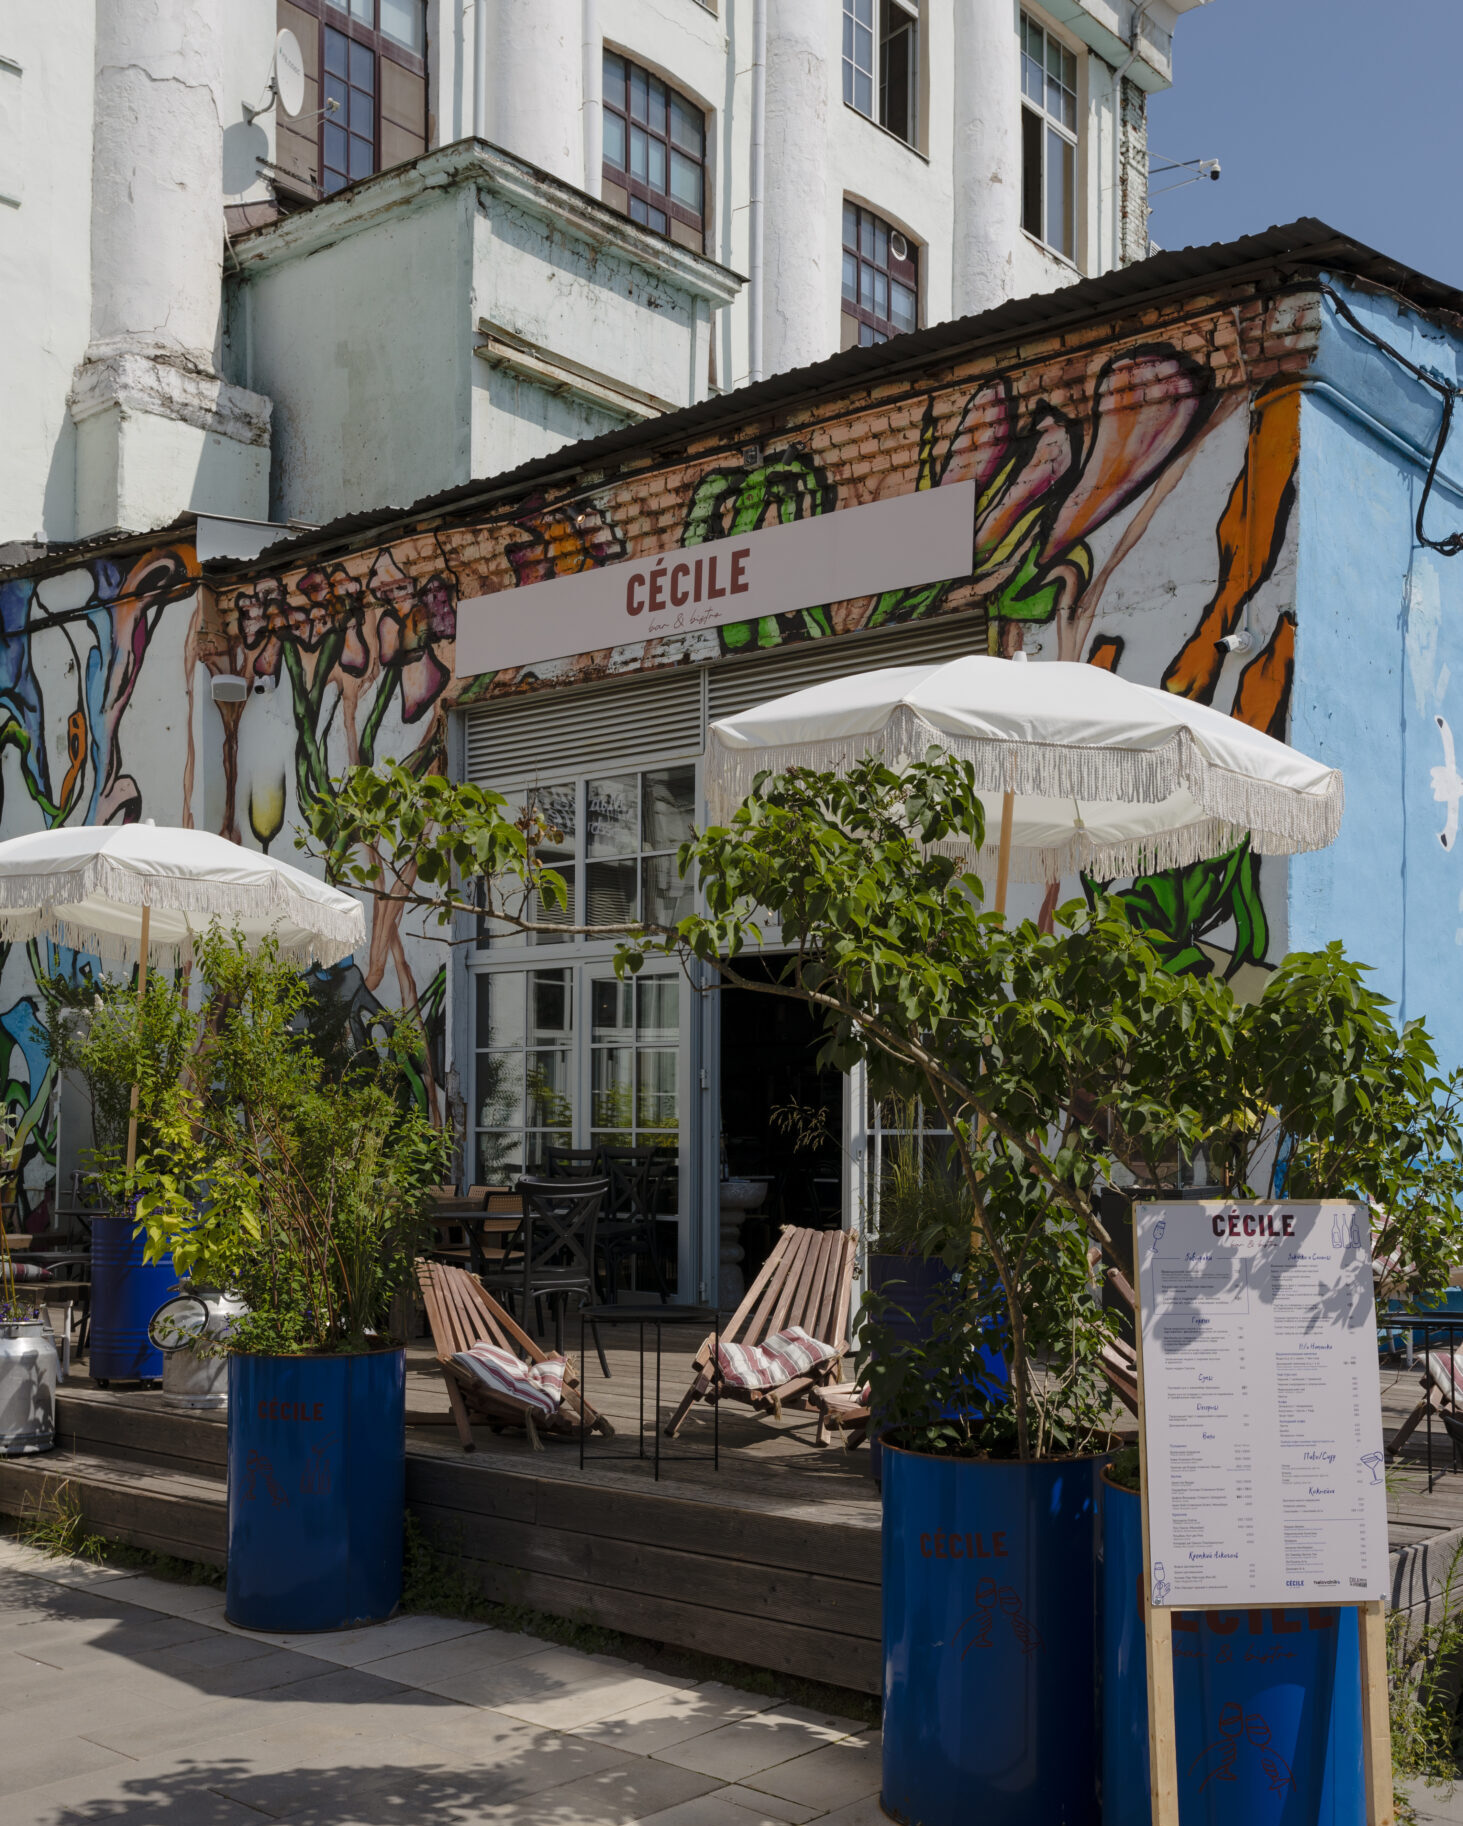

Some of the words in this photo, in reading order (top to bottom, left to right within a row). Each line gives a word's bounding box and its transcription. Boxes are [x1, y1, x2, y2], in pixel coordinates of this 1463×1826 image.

[626, 548, 751, 616] CÉCILE
[648, 618, 670, 632] bar
[673, 613, 685, 629] &
[690, 608, 722, 625] bistro
[1212, 1209, 1295, 1237] CÉCILE
[258, 1396, 325, 1421] CÉCILE
[919, 1527, 1009, 1558] CÉCILE
[1216, 1644, 1233, 1664] &
[1244, 1641, 1298, 1664] bistro
